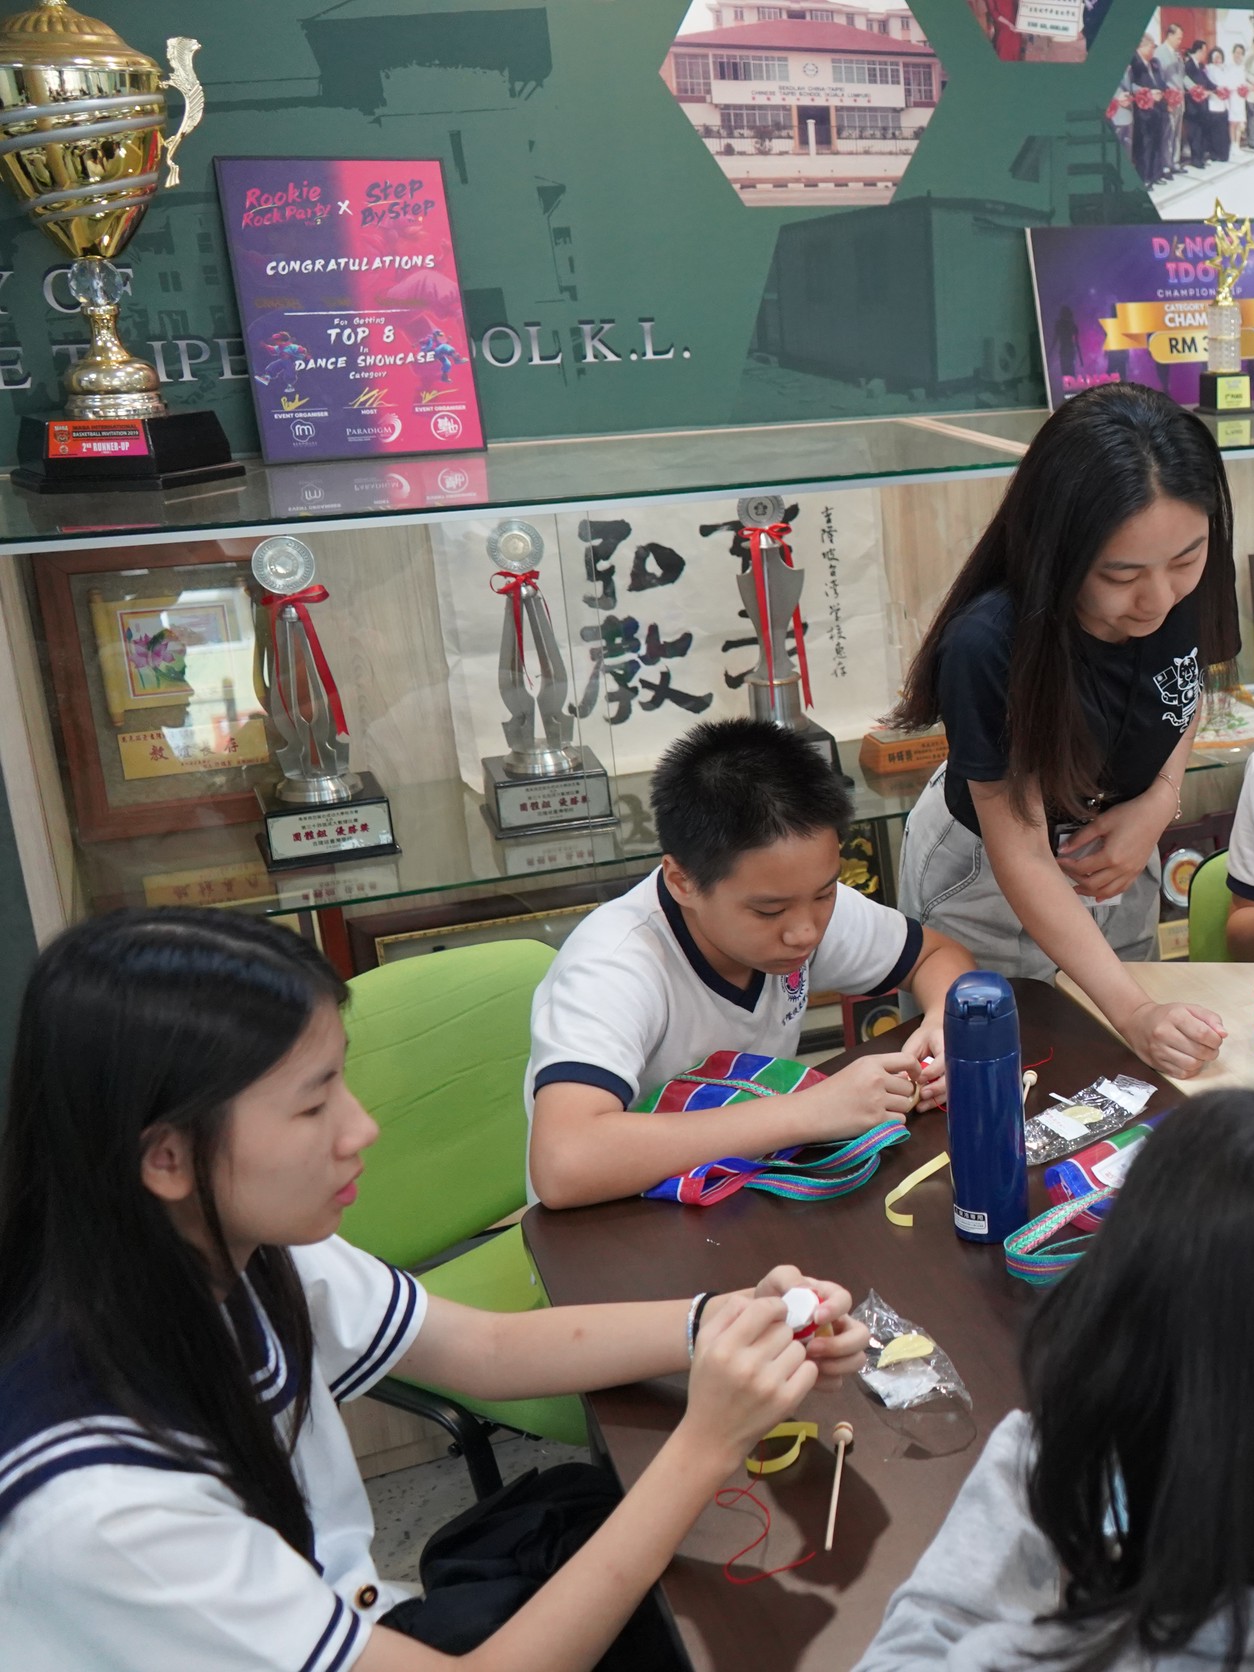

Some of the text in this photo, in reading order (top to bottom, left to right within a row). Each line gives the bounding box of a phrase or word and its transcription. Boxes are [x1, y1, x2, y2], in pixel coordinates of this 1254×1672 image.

[365, 179, 423, 204] Step
[266, 254, 435, 276] CONGRATULATIONS
[334, 316, 386, 326] For Getting
[326, 325, 395, 346] TOP 8
[578, 316, 692, 364] K.L.
[1169, 336, 1198, 354] RM
[294, 351, 436, 372] DANCE SHOWCASE
[349, 370, 387, 380] Category
[273, 410, 329, 420] EVENT ORGANISER
[346, 426, 393, 437] PARADIGM
[93, 441, 130, 452] RUNNER-UP
